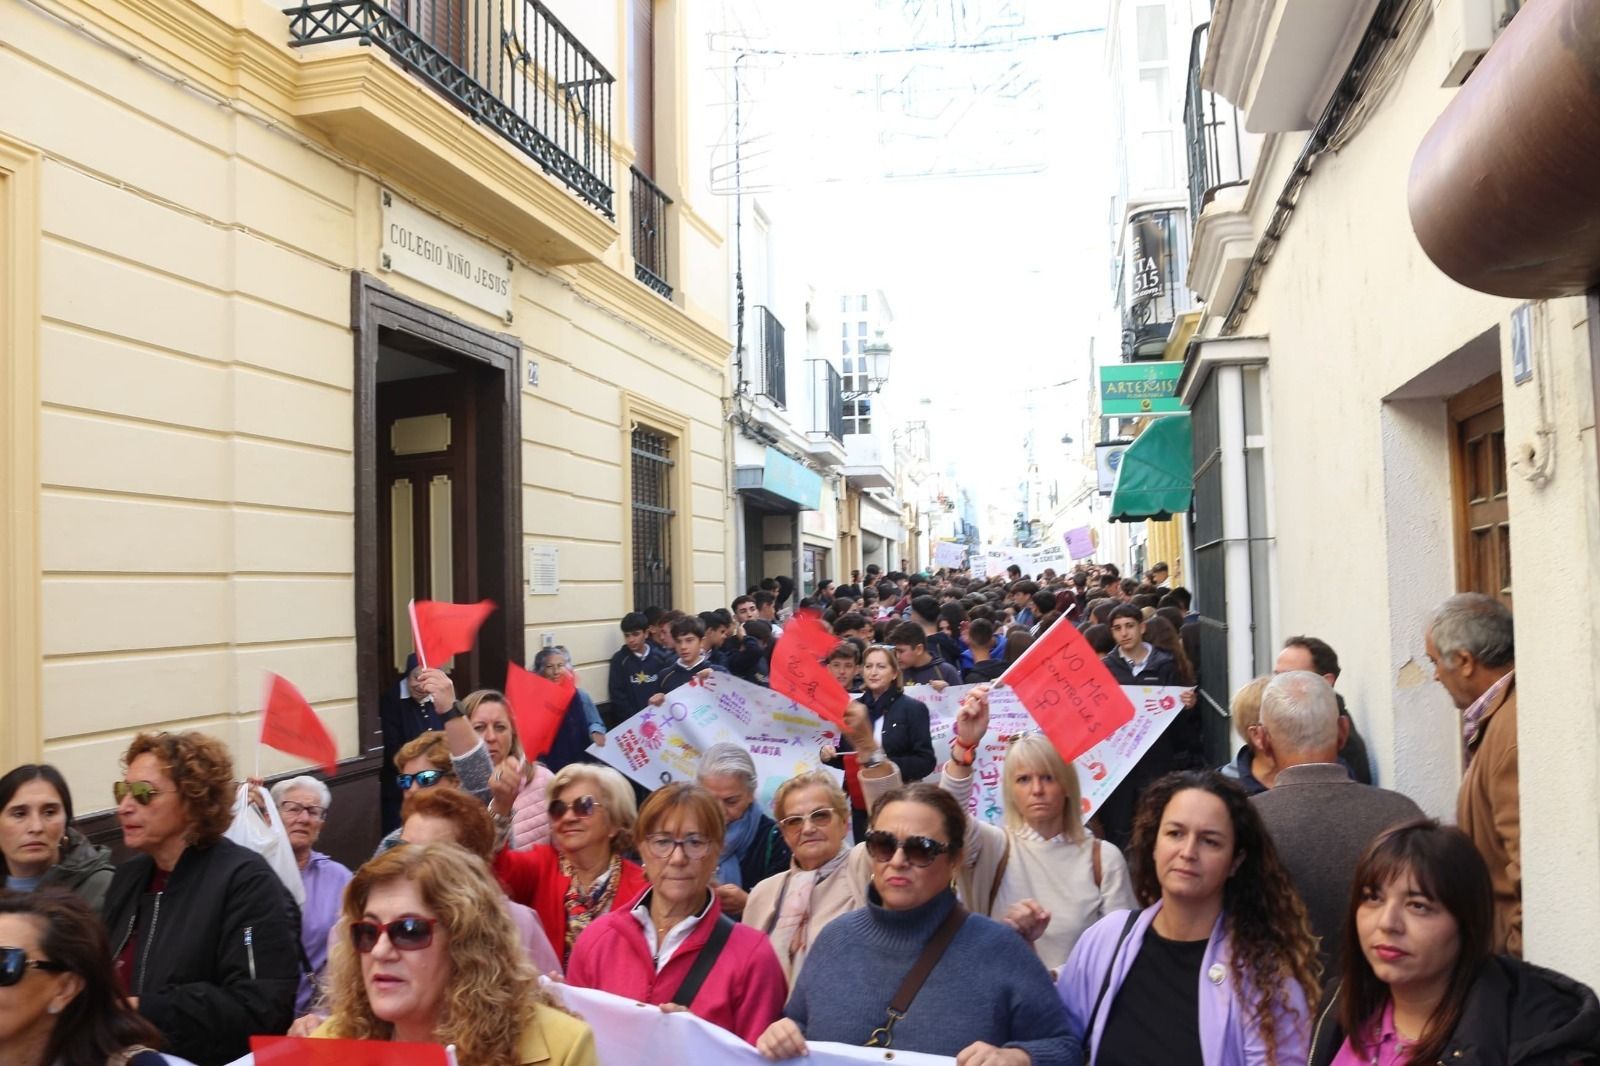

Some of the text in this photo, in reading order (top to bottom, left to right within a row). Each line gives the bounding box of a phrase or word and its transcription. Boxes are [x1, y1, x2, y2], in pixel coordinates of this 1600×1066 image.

[390, 223, 442, 266] COLEGIO
[1511, 305, 1532, 376] 21
[1106, 379, 1173, 394] ARTEMIS
[1056, 642, 1109, 708] NO ME
[750, 745, 782, 756] MATA
